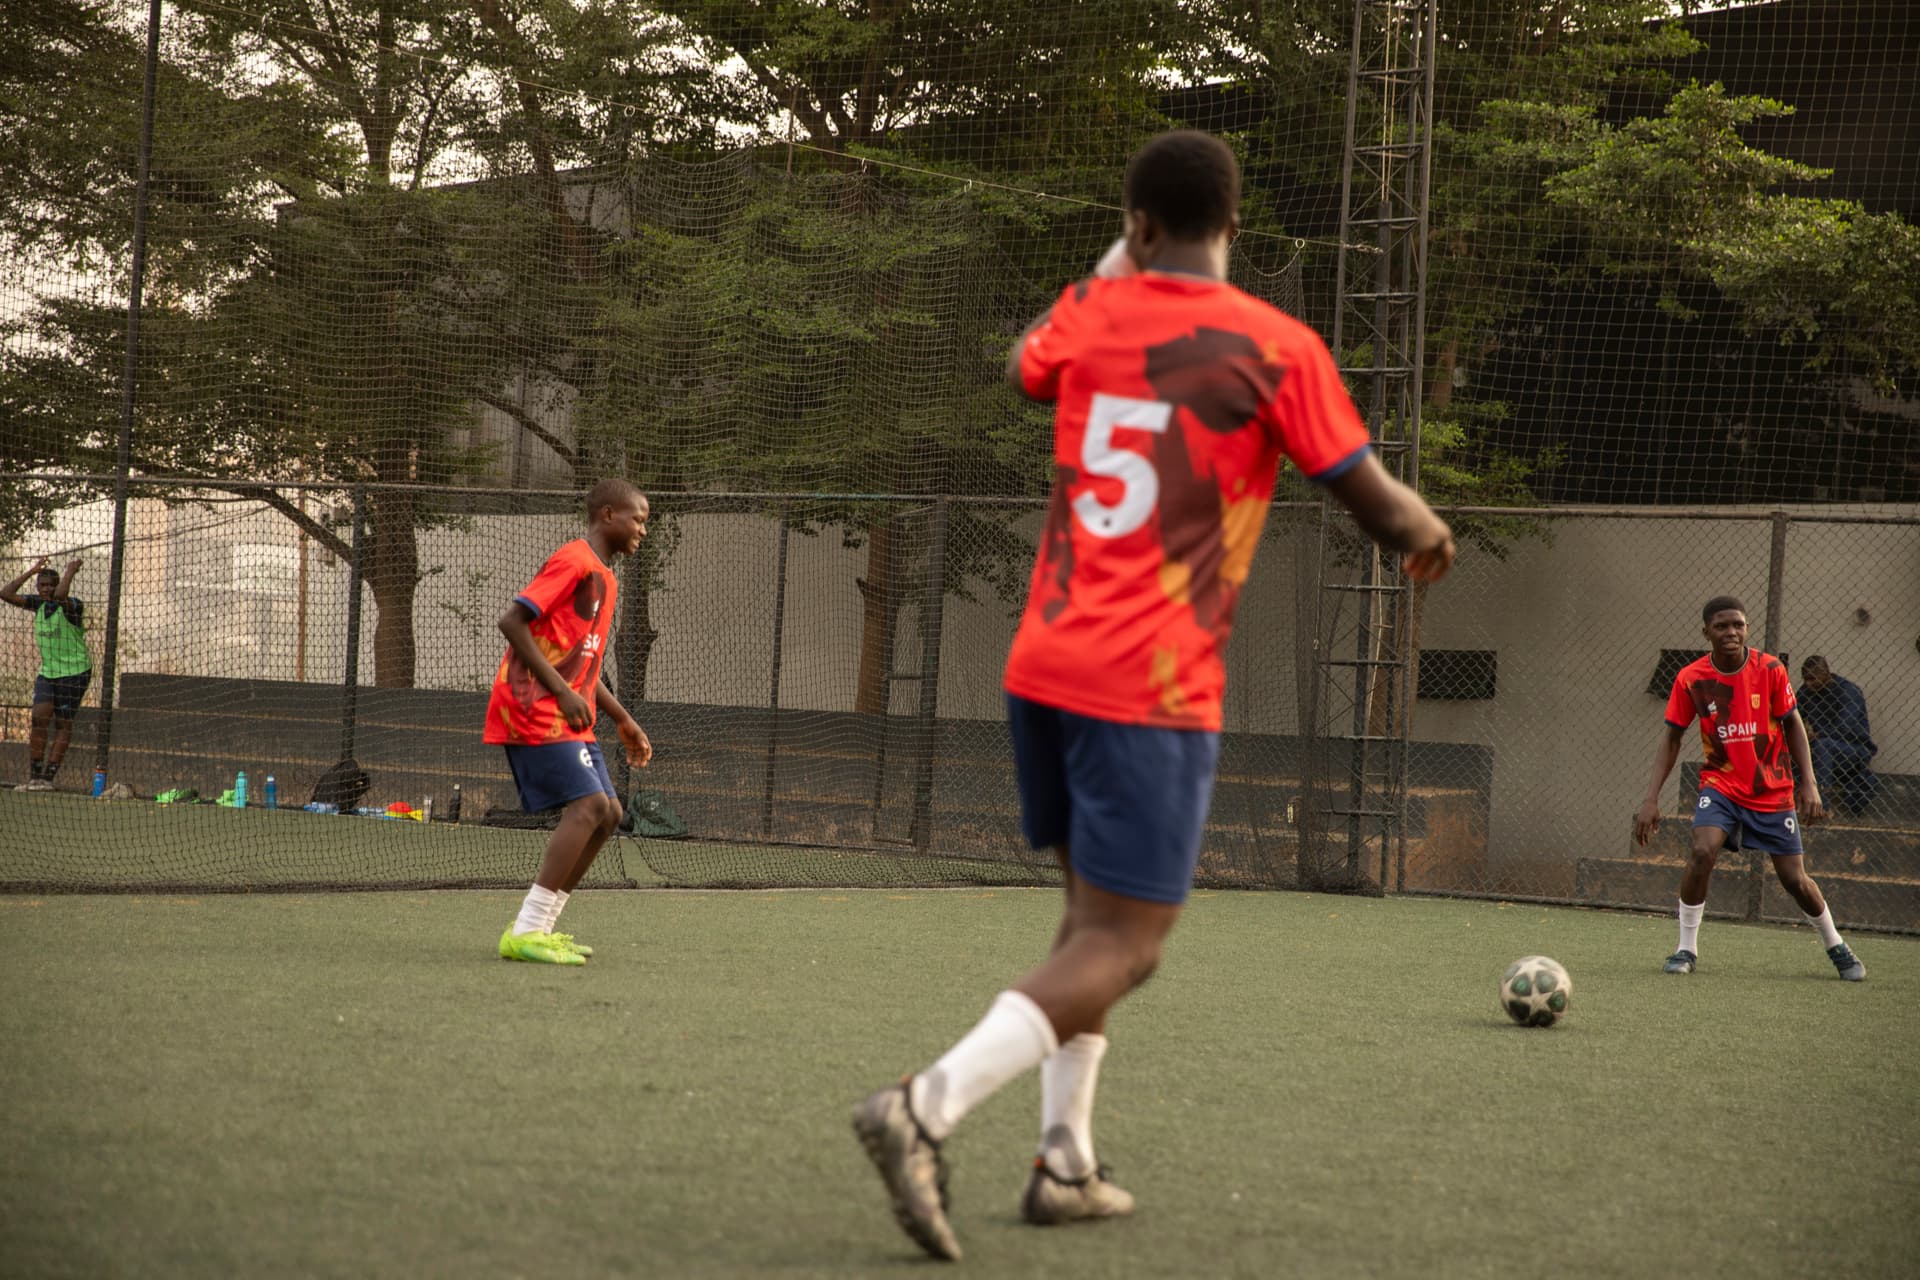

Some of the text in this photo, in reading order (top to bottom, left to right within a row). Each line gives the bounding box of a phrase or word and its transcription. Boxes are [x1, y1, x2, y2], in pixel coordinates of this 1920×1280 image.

[1073, 393, 1172, 538] 5
[1717, 722, 1757, 738] SPAIN
[1784, 817, 1795, 834] 9
